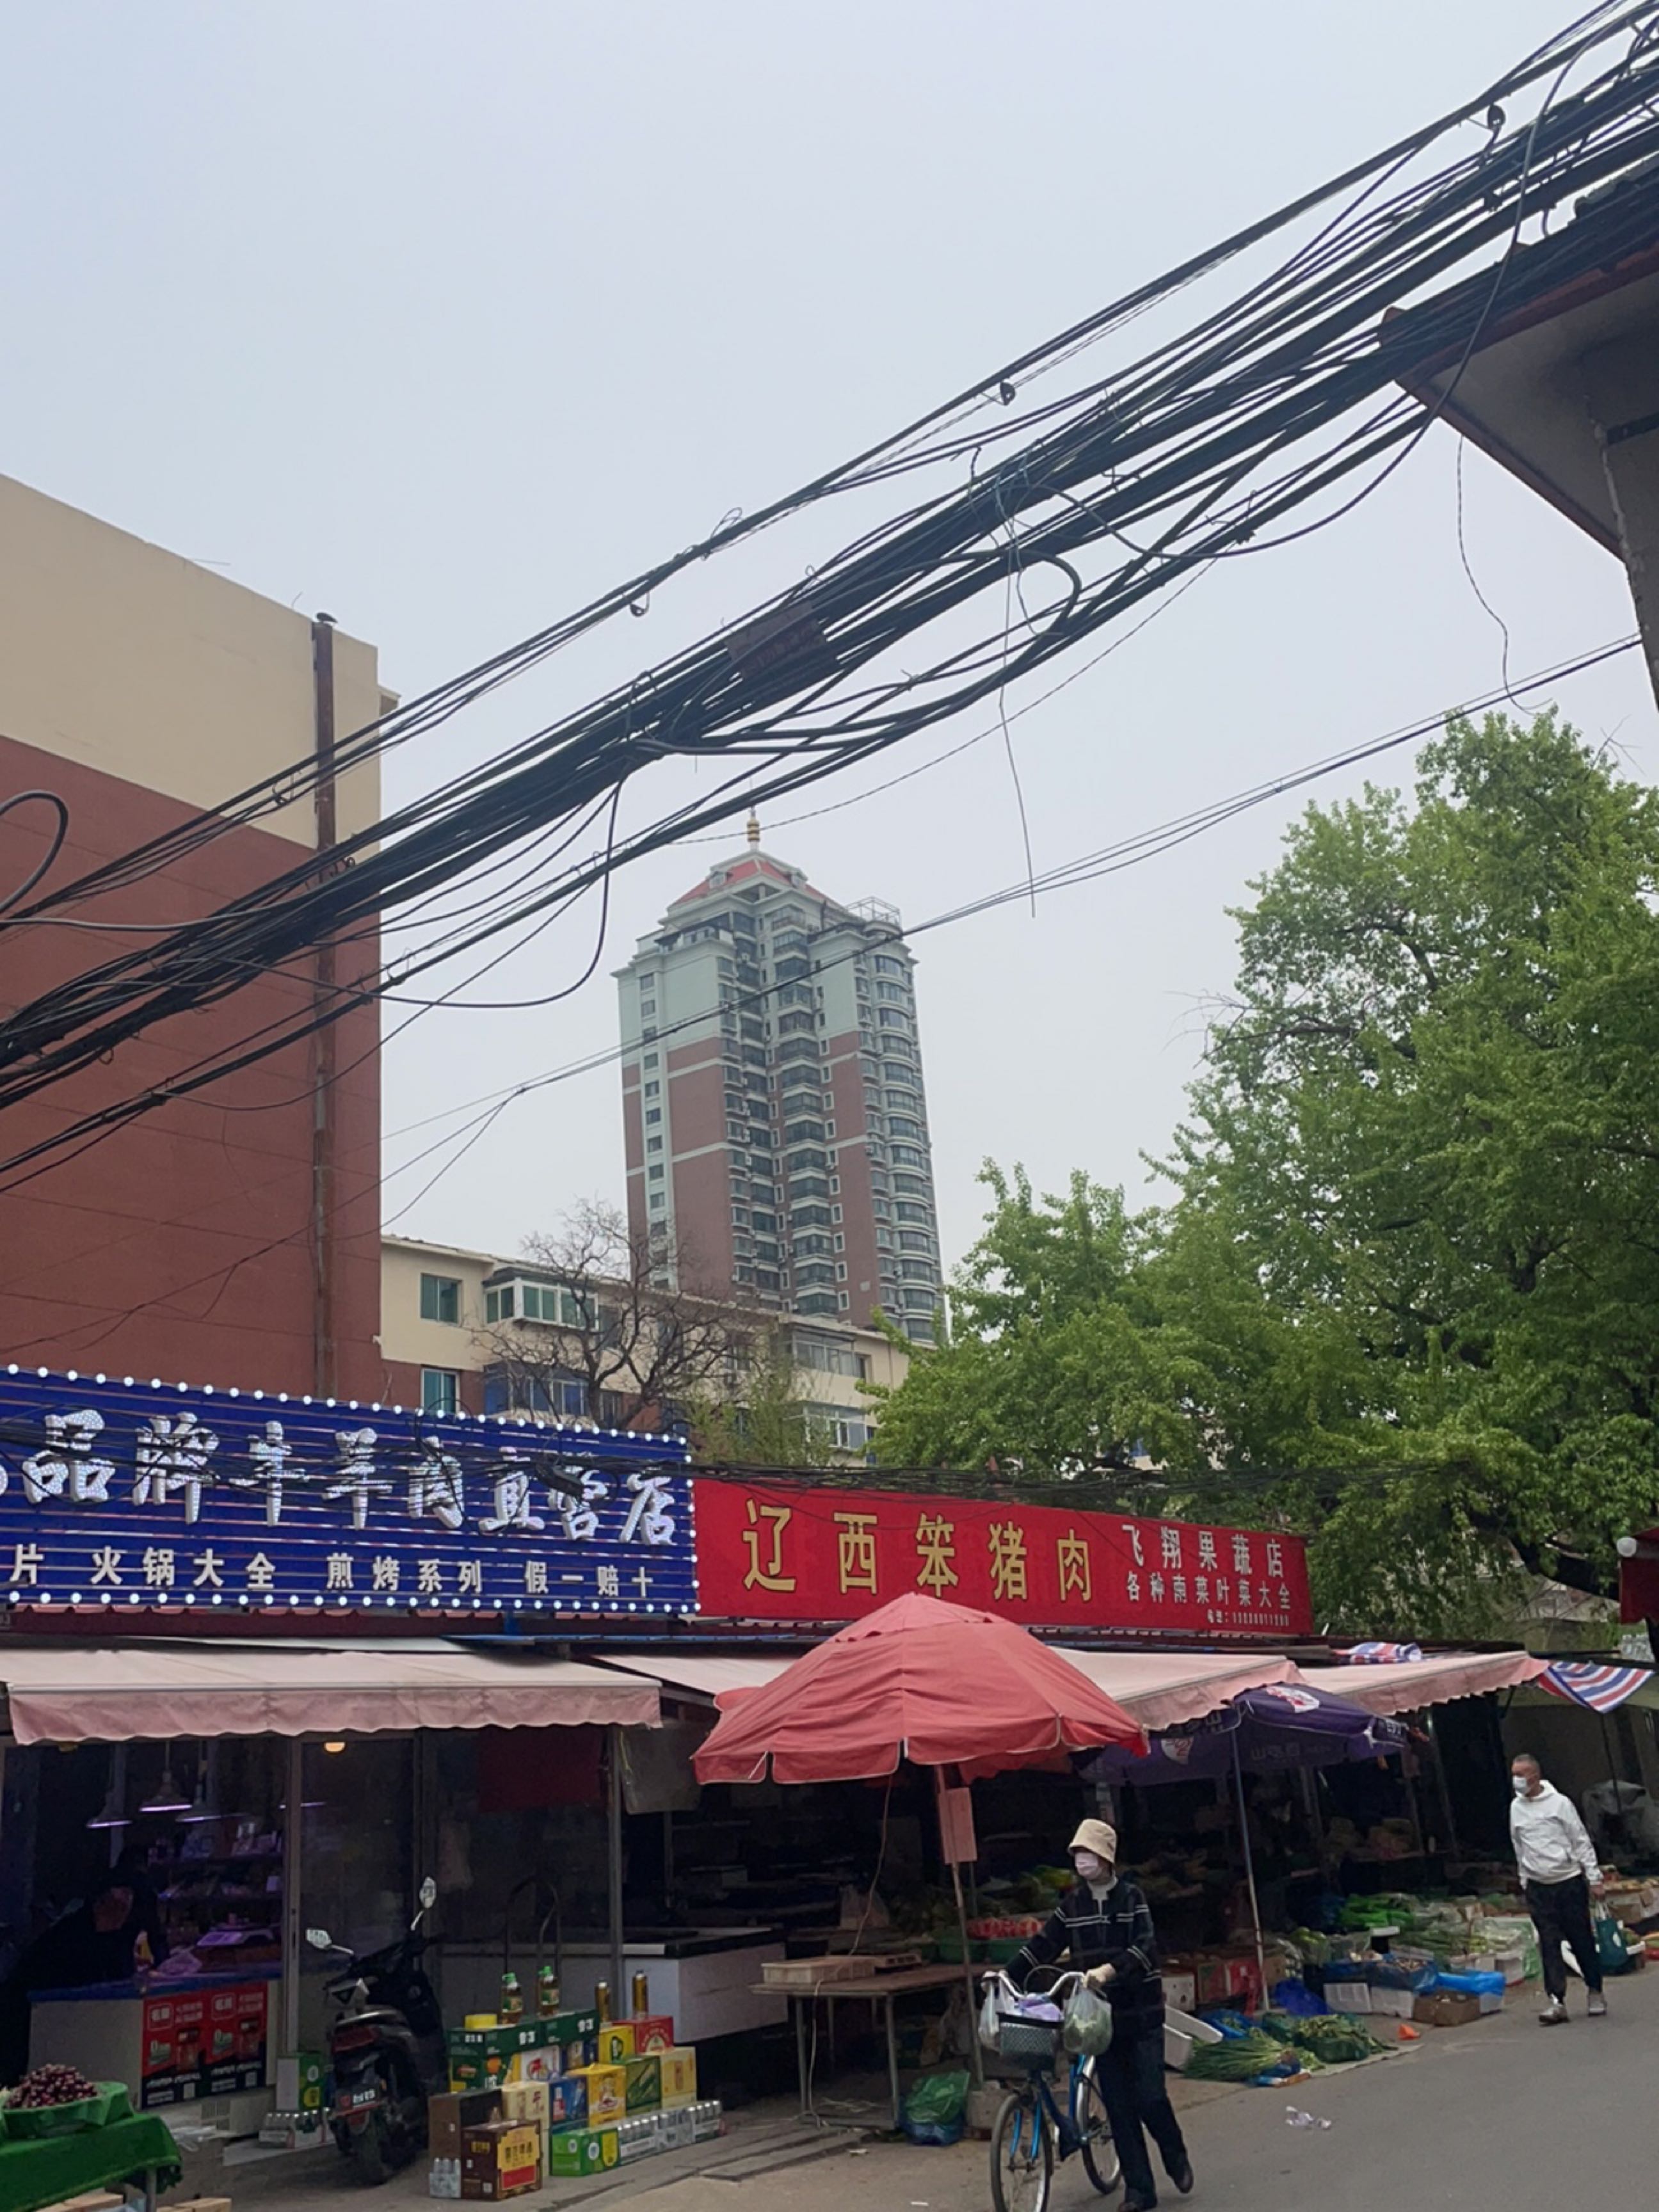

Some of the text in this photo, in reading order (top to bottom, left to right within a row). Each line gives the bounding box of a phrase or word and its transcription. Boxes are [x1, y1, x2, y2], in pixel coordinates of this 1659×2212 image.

[0, 1409, 678, 1544] 品牌牛羊肉直营店
[10, 1543, 653, 1598] 片 火锅大全 煎烤系列 假一赔十
[743, 1499, 1091, 1601] 辽西笨猪肉
[1122, 1525, 1283, 1578] 飞翔果蔬店
